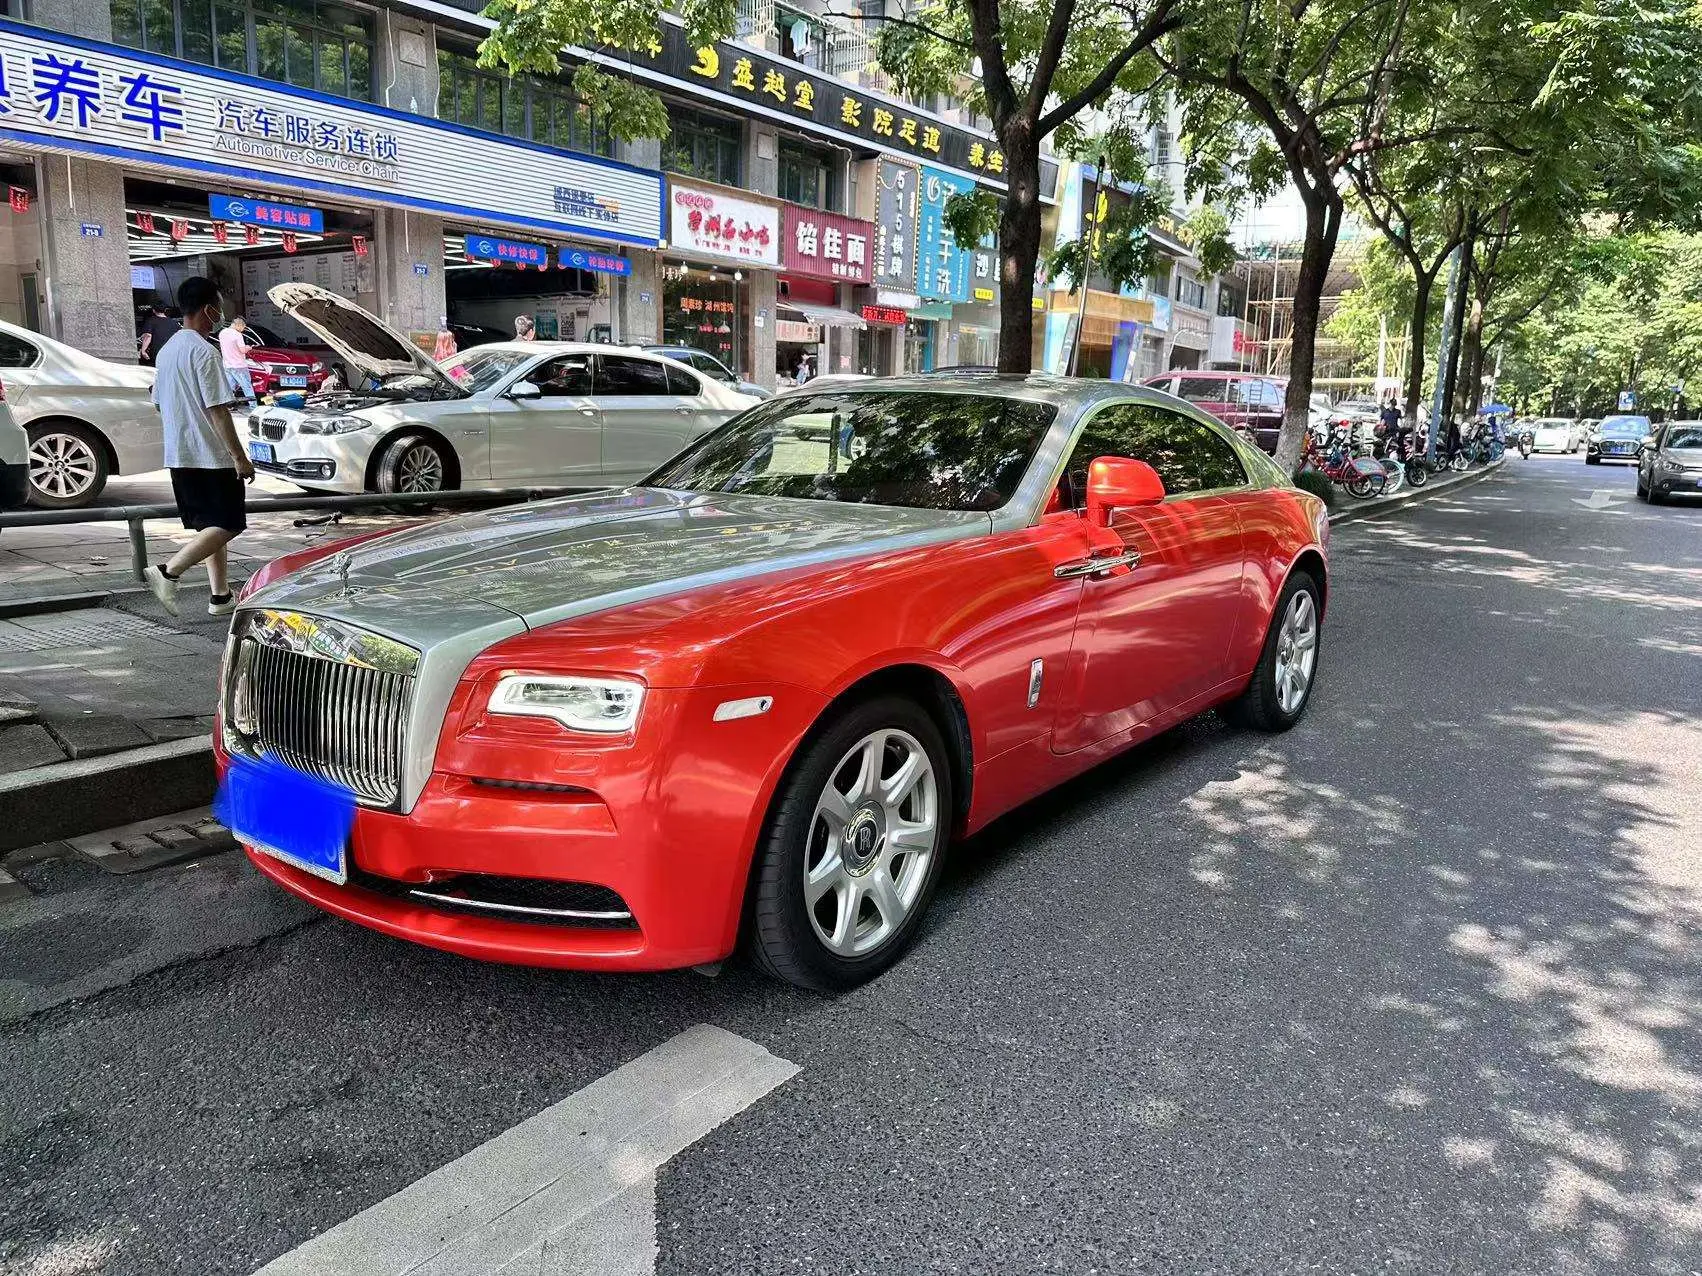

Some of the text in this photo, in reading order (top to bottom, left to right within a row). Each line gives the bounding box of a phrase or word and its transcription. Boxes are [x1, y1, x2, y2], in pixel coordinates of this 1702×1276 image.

[217, 99, 400, 163] 汽车服务连锁
[840, 96, 942, 153] 影院足道
[215, 134, 400, 181] Automotive Service Chain
